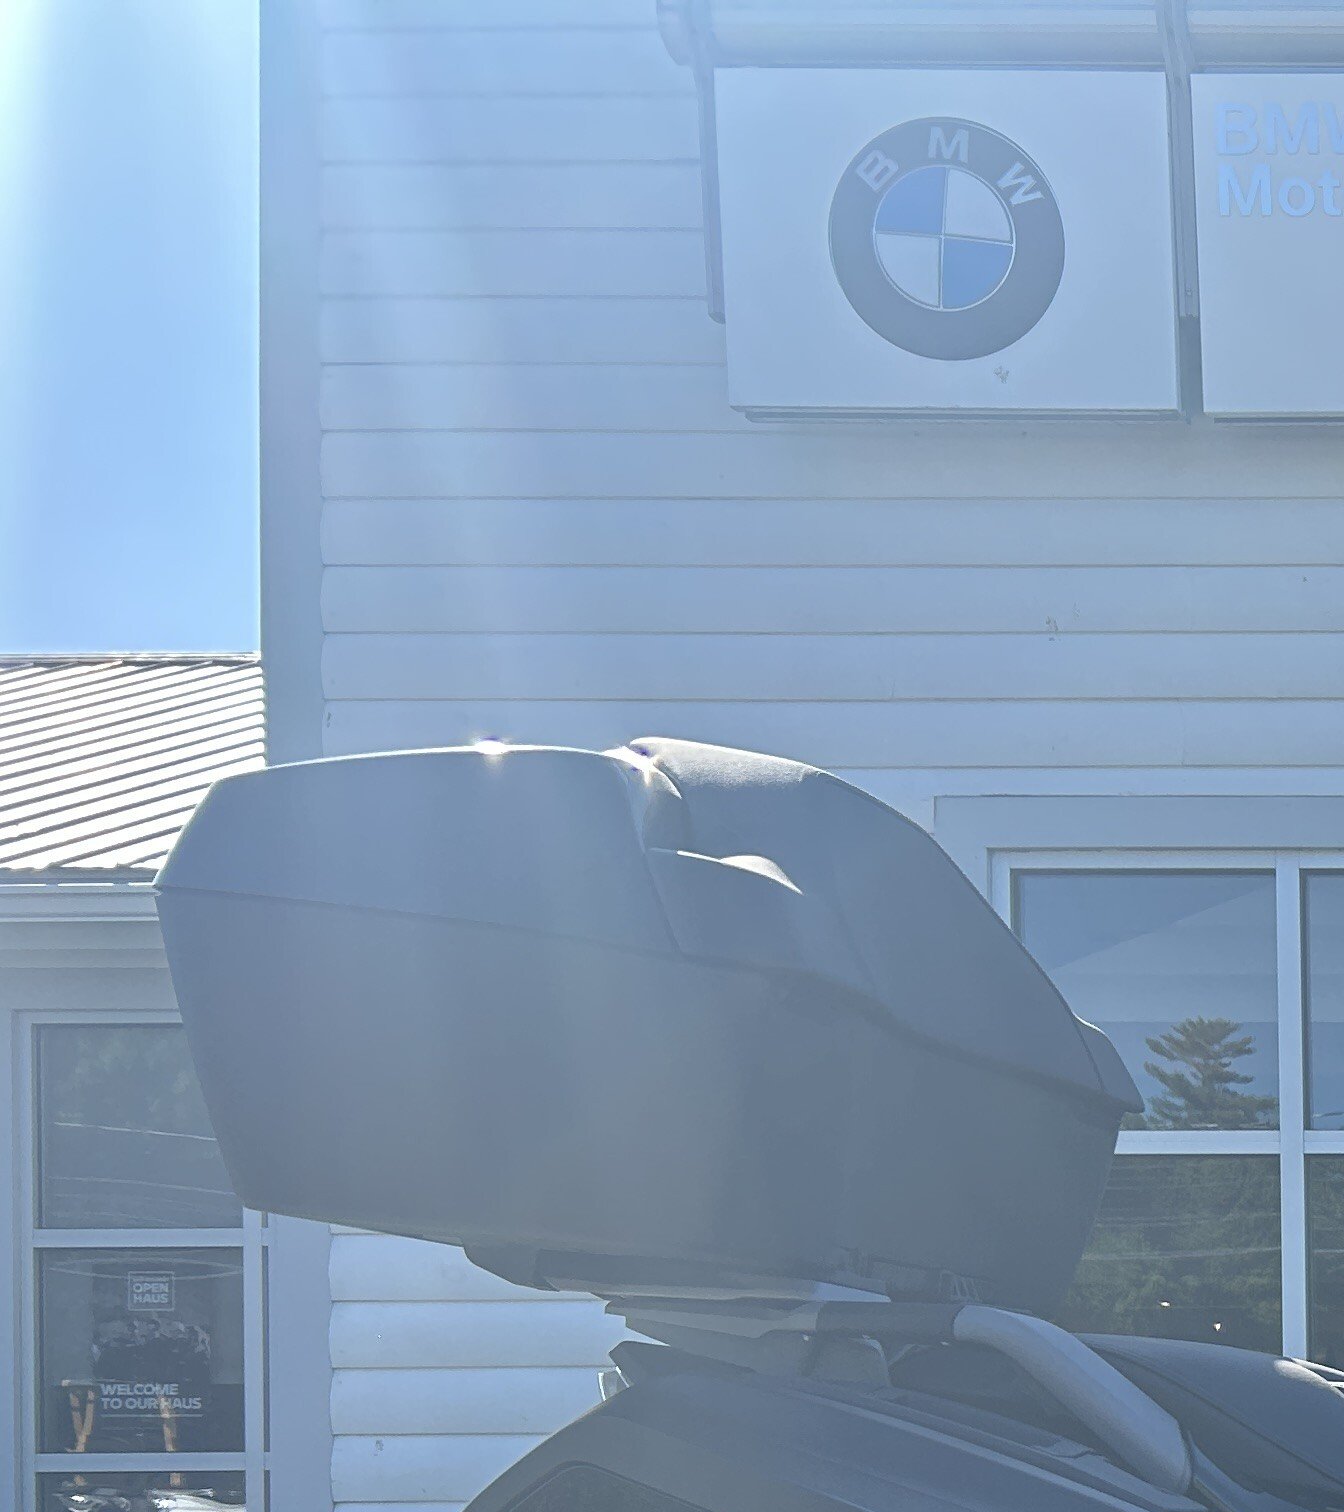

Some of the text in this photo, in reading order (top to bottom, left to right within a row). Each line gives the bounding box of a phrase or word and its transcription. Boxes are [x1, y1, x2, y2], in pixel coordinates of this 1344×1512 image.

[856, 126, 1046, 207] BMW
[132, 1283, 169, 1293] OPEN
[133, 1293, 169, 1304] HAUS
[101, 1383, 179, 1396] WELCOME
[101, 1397, 202, 1410] TO OUR HAUS
